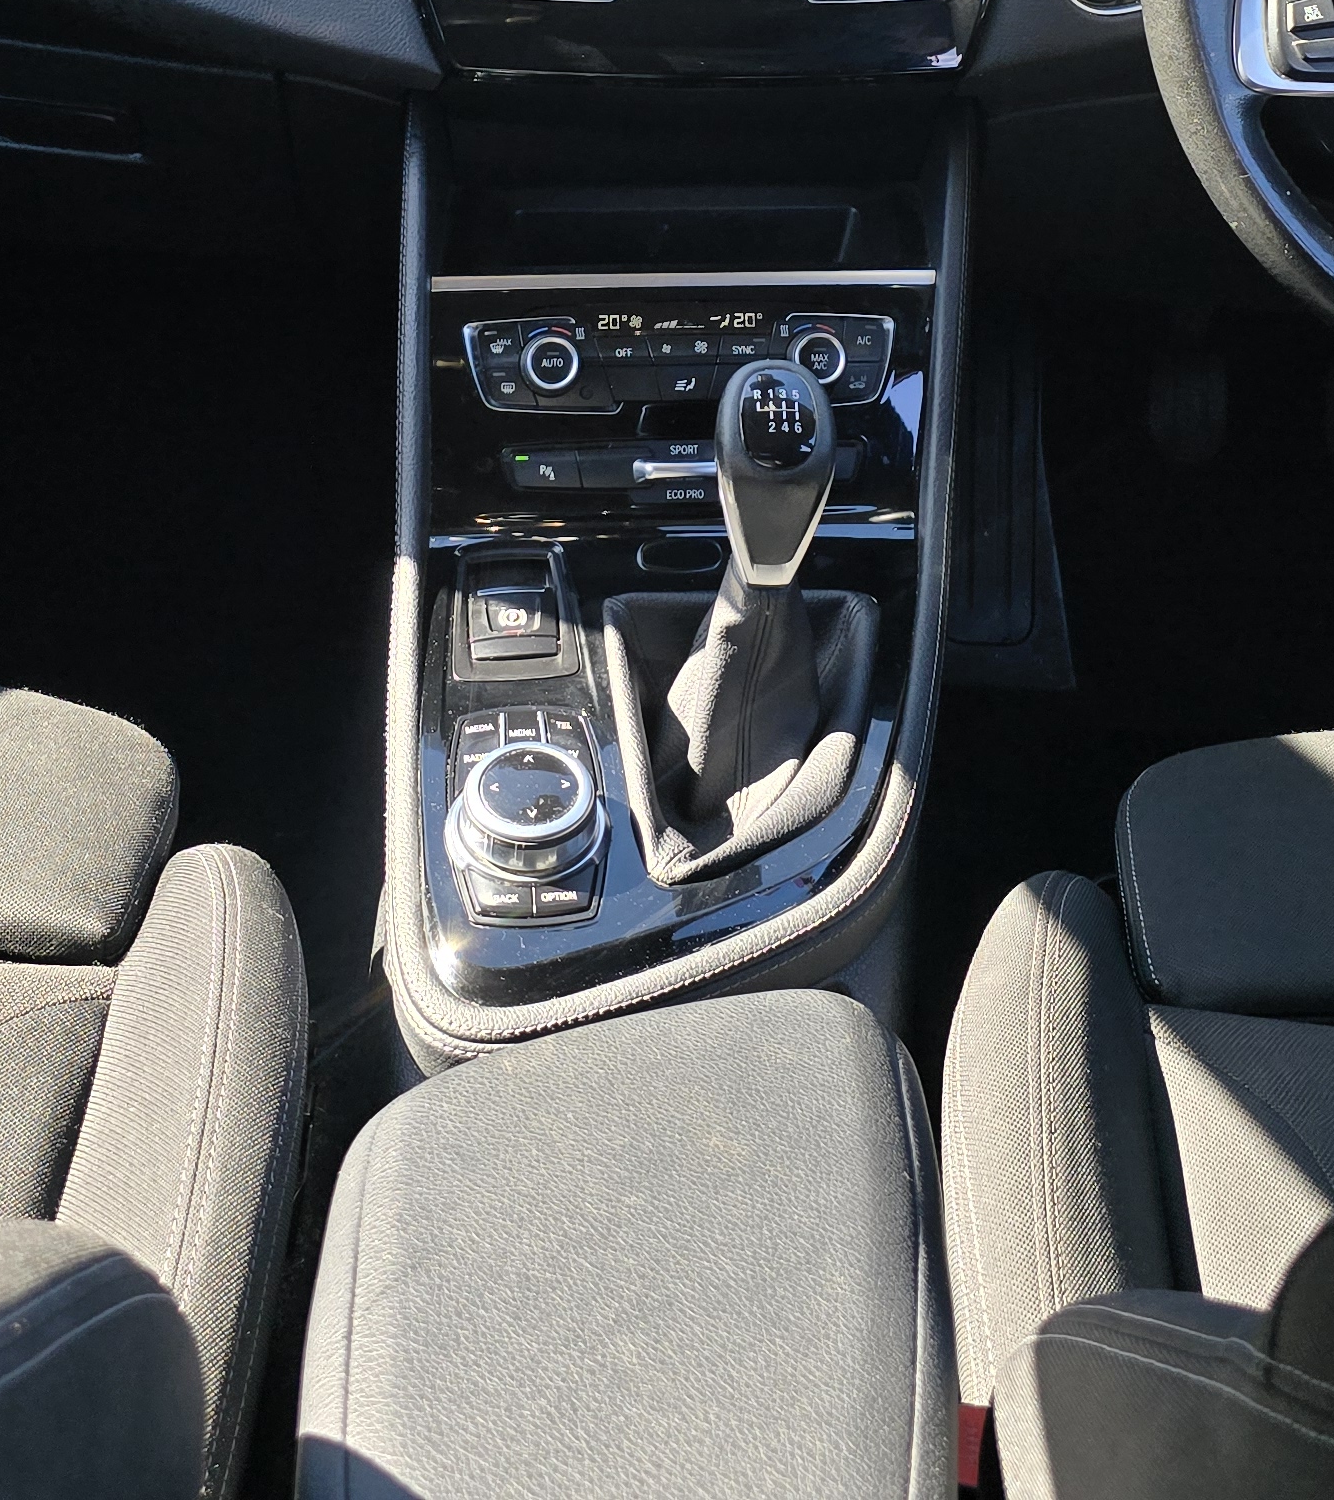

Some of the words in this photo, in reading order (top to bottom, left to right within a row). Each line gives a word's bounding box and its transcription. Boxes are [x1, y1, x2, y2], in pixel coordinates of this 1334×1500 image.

[497, 338, 512, 346] MAX
[856, 335, 872, 345] A/C
[615, 348, 633, 358] OFF
[732, 345, 755, 355] SYNC
[541, 358, 564, 367] AUTO
[810, 353, 829, 362] MAX
[813, 361, 828, 370] A/C
[754, 389, 762, 399] R
[768, 388, 774, 398] 1
[779, 388, 787, 399] 3
[792, 389, 800, 399] 5
[768, 421, 776, 432] 2
[781, 421, 789, 432] 4
[794, 422, 802, 434] 6
[669, 444, 699, 455] SPORT
[666, 489, 685, 500] ECO
[686, 488, 705, 499] PRO
[465, 722, 495, 734] MEDIA
[508, 728, 536, 737] MENU
[492, 892, 519, 904] BACK
[540, 890, 578, 902] OPTION
